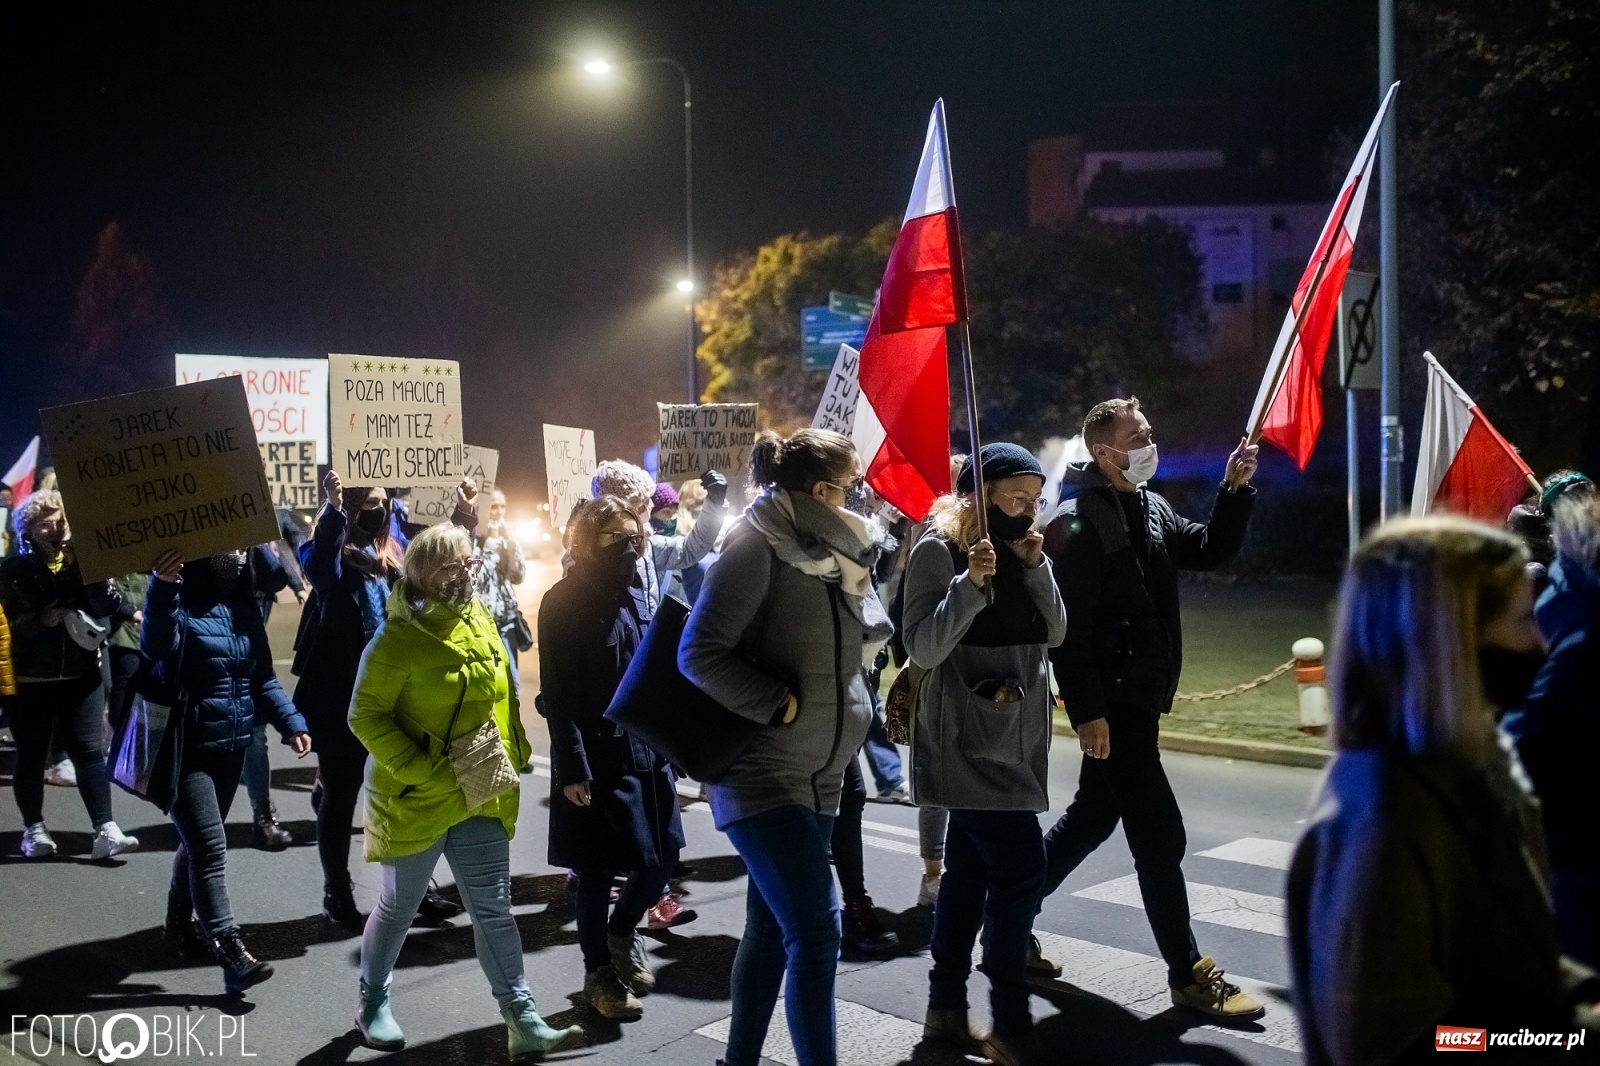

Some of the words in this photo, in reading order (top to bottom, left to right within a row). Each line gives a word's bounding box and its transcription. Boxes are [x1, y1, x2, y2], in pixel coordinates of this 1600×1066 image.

[841, 351, 859, 380] WI
[344, 379, 384, 401] POZA
[834, 373, 853, 398] TU
[109, 406, 182, 441] JAREK
[250, 401, 306, 435] OŚCI
[366, 414, 400, 438] MAM
[661, 408, 698, 430] JAREK
[701, 409, 718, 428] TO
[723, 409, 757, 428] TWOJA
[660, 432, 687, 450] WINA
[692, 431, 726, 449] TWOJA
[77, 442, 168, 483] KOBIETA
[171, 435, 201, 462] TO
[204, 427, 240, 456] NIE
[347, 442, 392, 479] MÓZG
[396, 447, 400, 478] I
[659, 452, 700, 475] WIELKA
[706, 453, 731, 470] WINA
[127, 472, 197, 508] JAJKO
